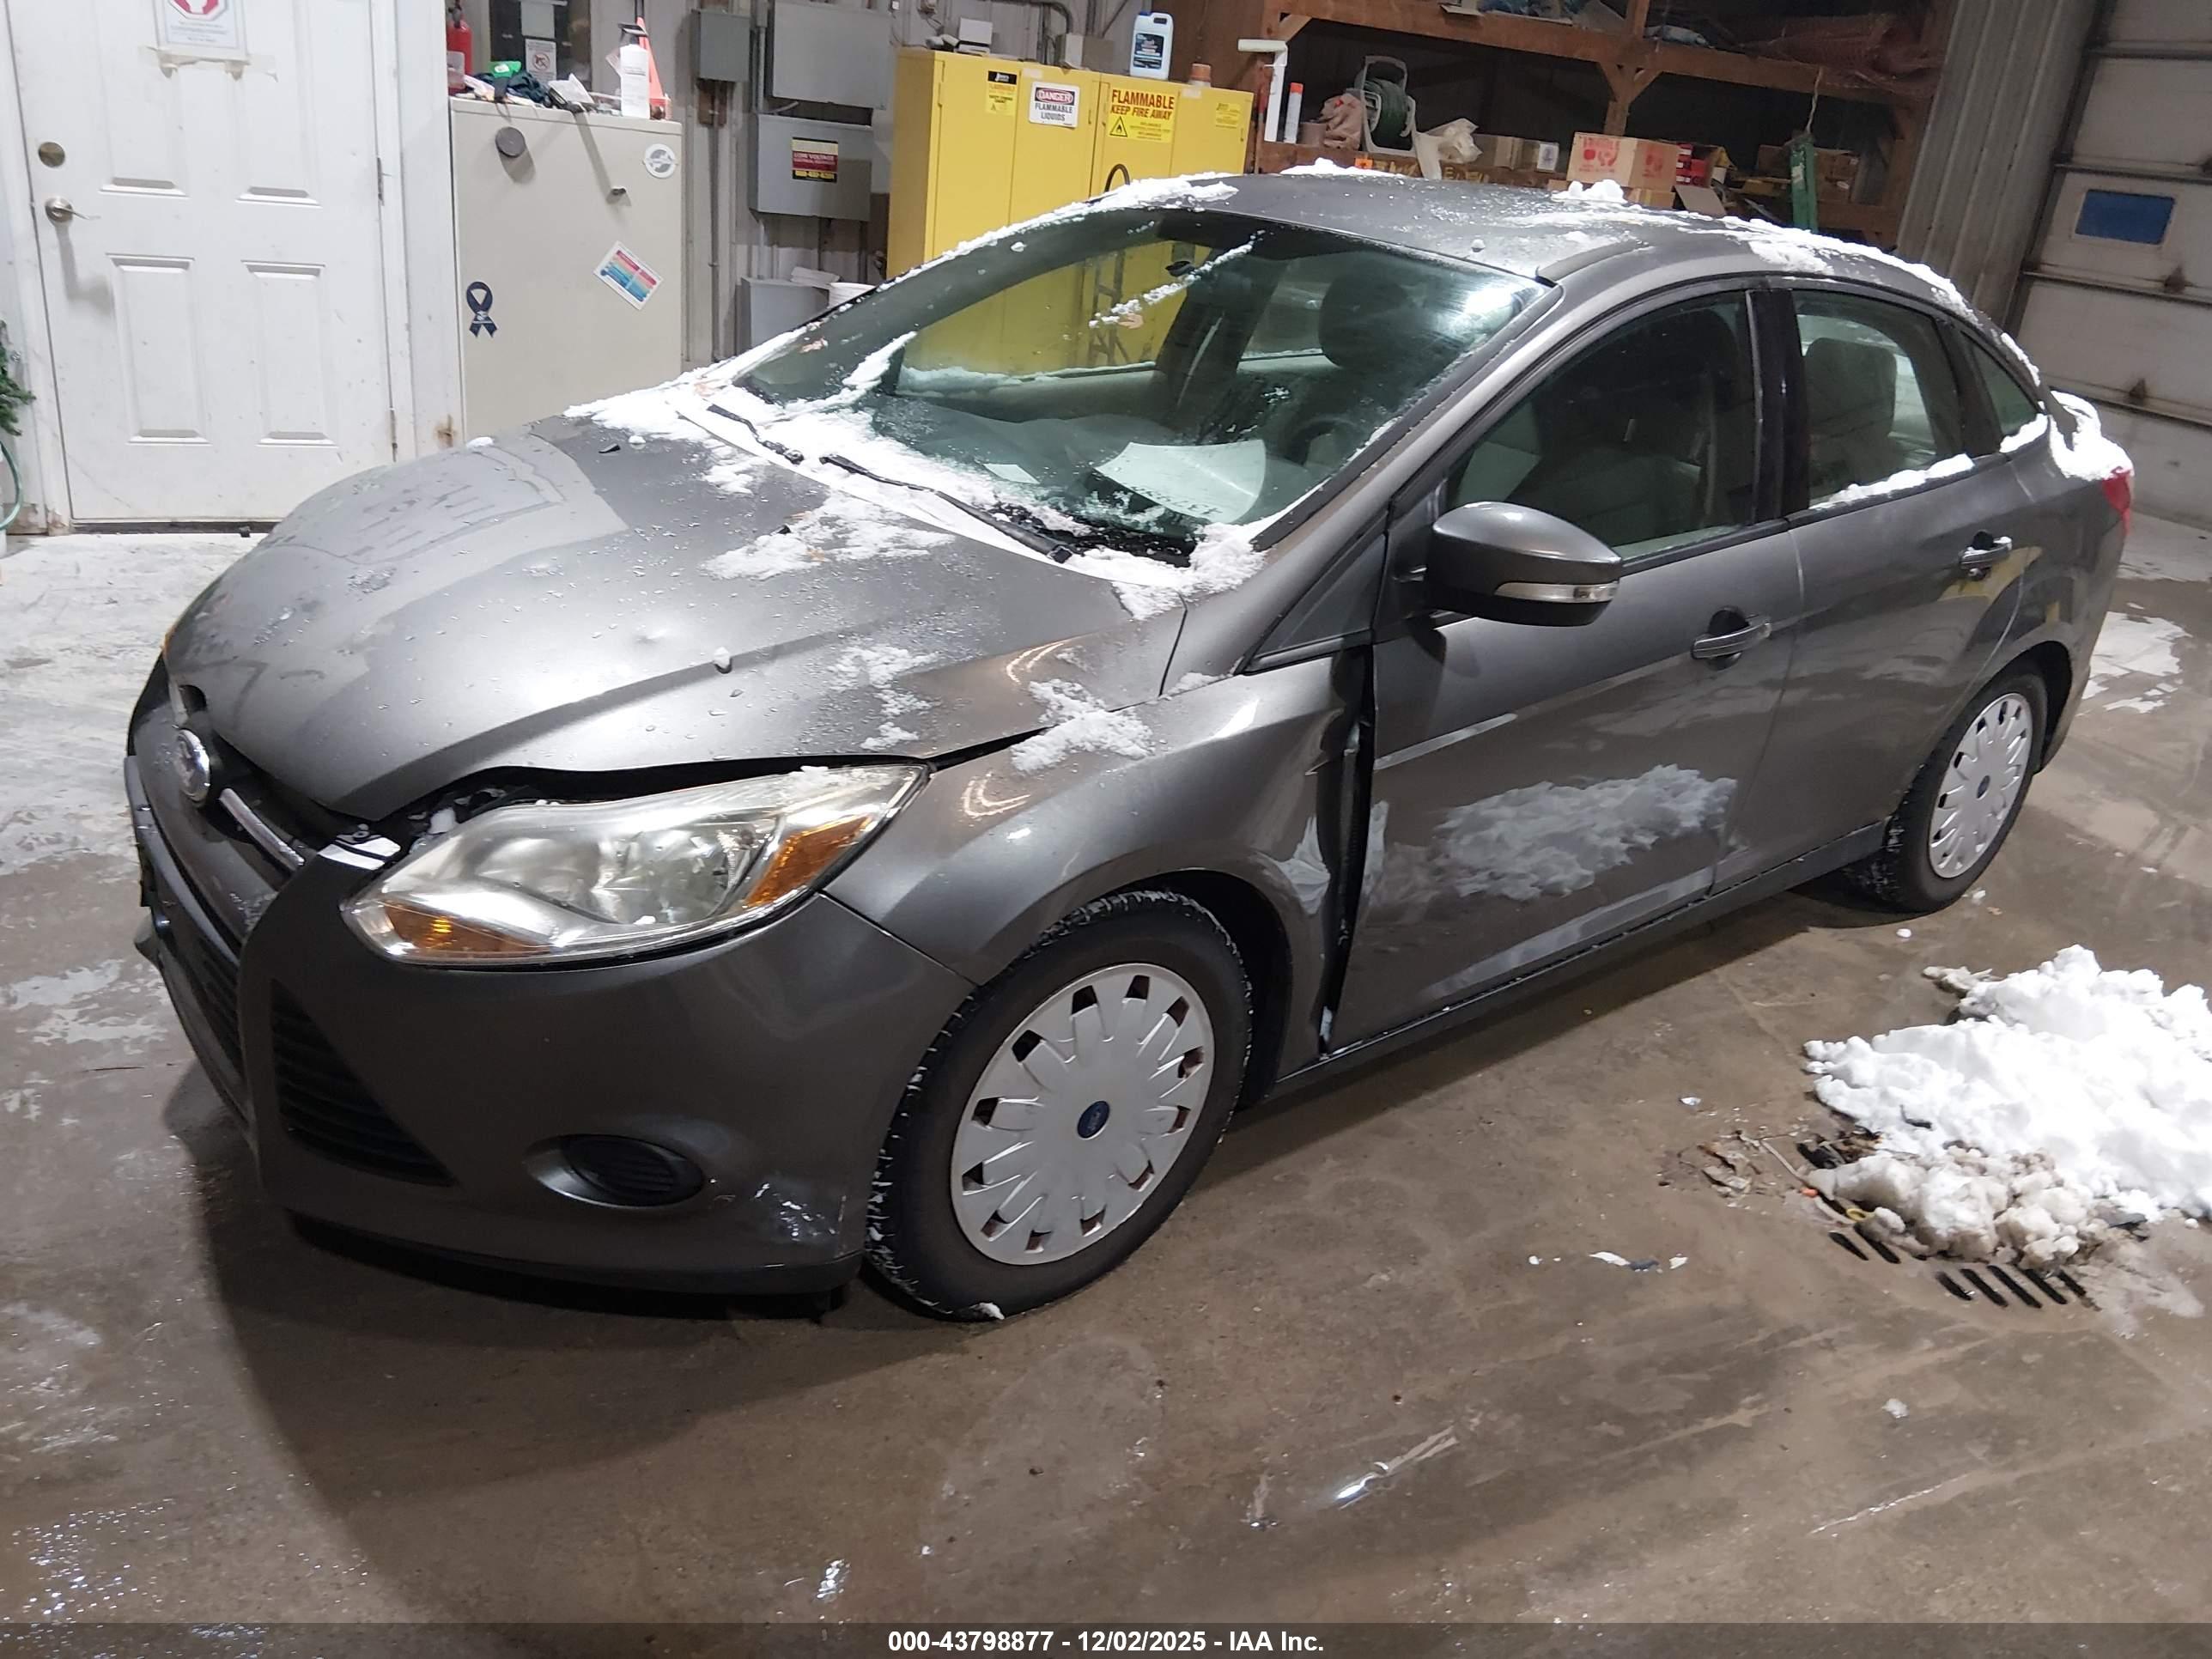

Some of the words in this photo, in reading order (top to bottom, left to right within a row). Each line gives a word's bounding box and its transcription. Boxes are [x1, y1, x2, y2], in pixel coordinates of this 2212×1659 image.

[1037, 89, 1073, 103] DANGER
[1112, 89, 1175, 110] FLAMMABLE
[1035, 103, 1073, 113] FLAMMABLE
[1110, 105, 1131, 115] KEEP
[1132, 107, 1149, 118] FIRE
[1150, 110, 1173, 121] AWAY
[1041, 112, 1066, 122] LIQUIDS
